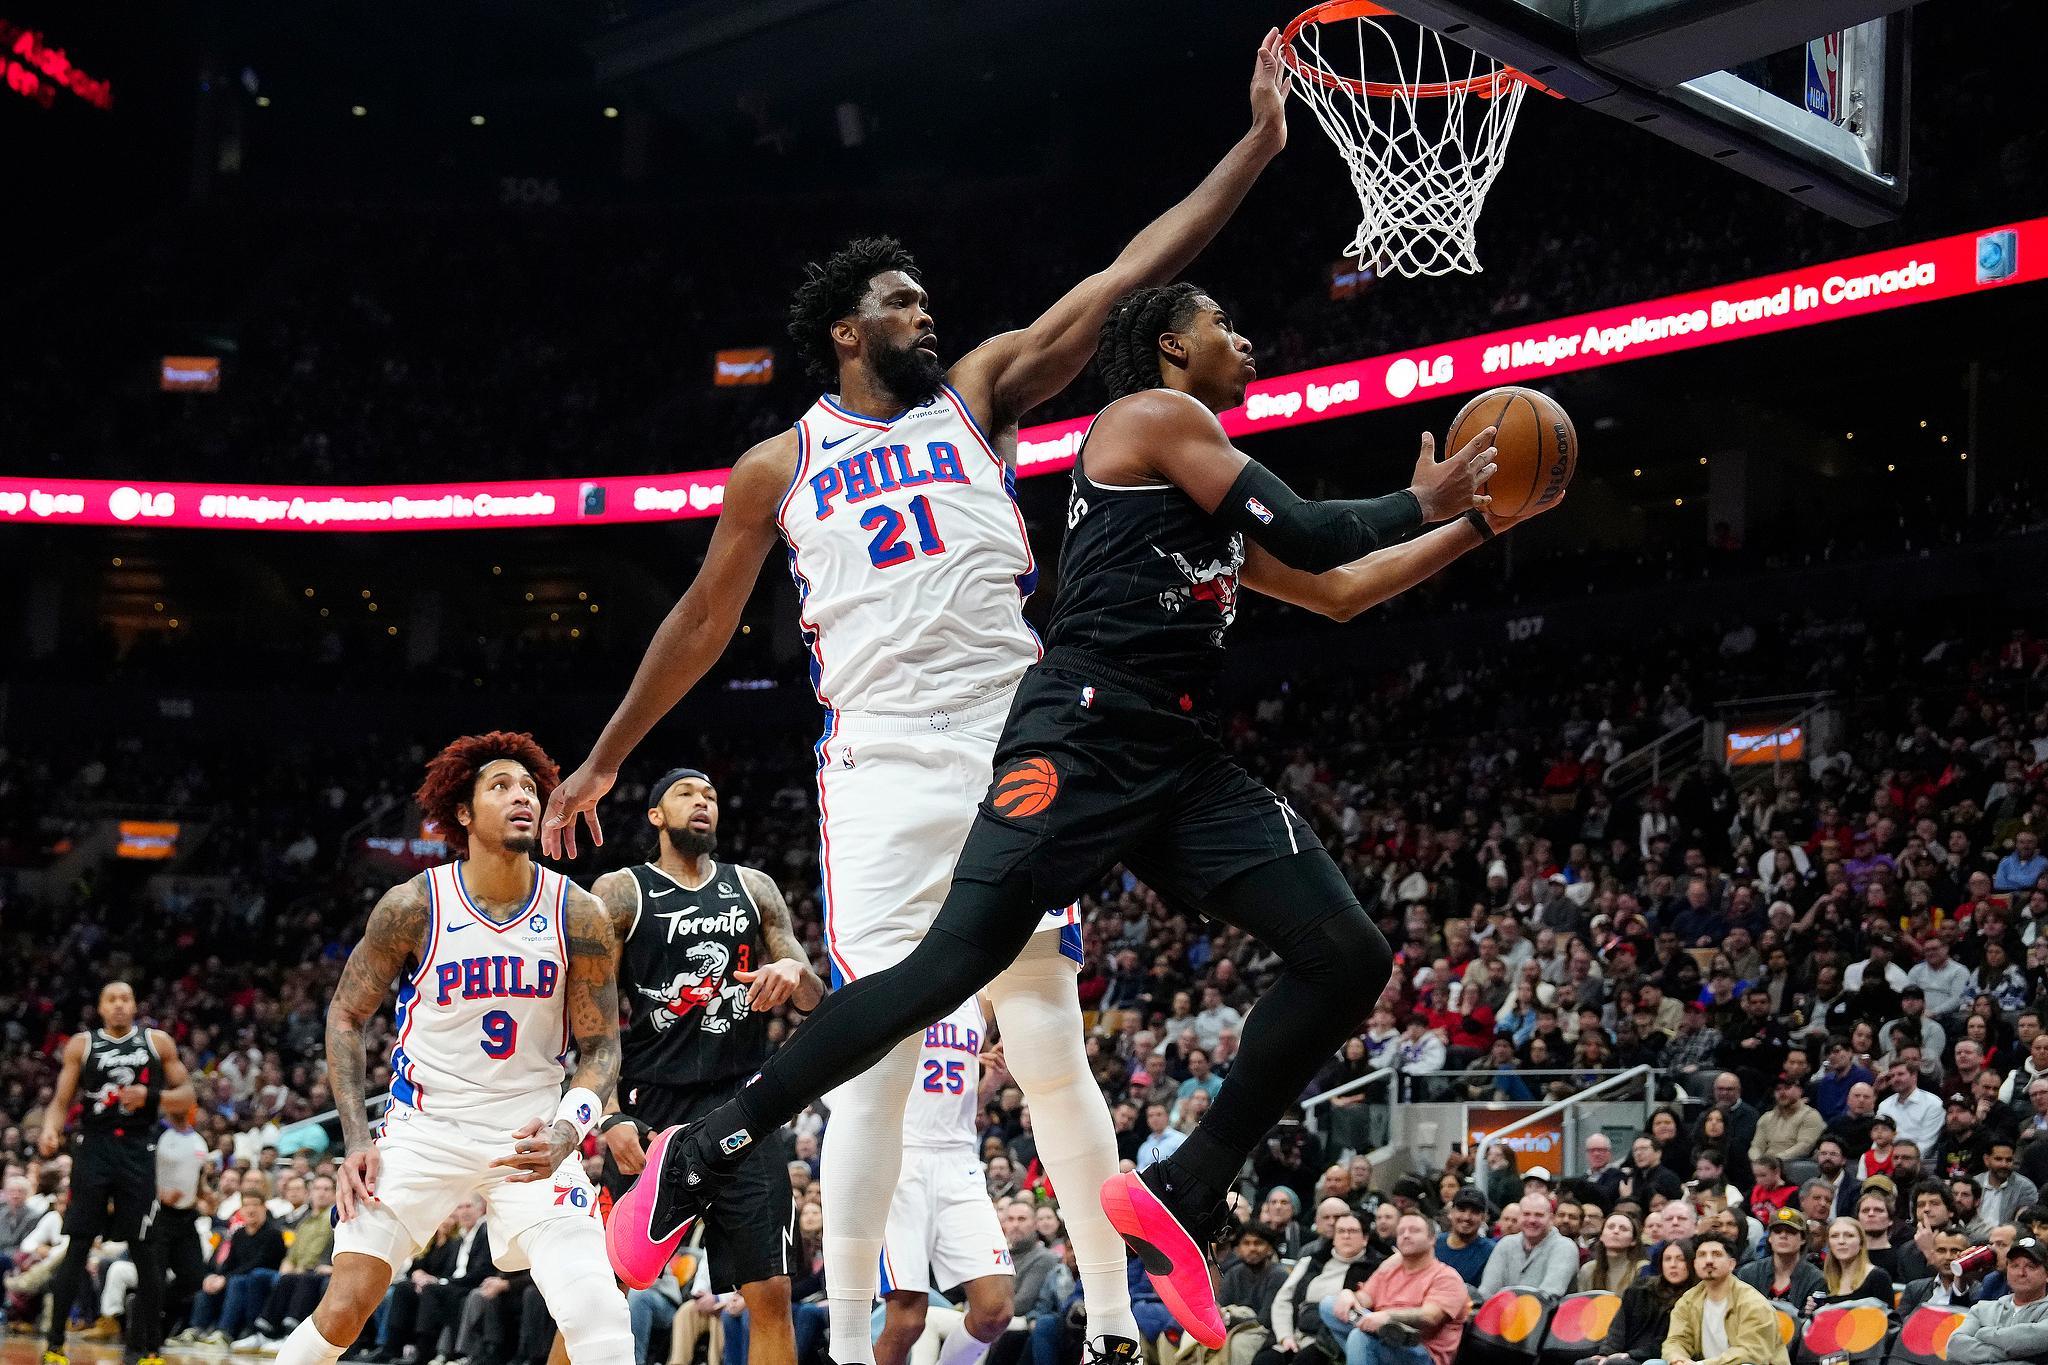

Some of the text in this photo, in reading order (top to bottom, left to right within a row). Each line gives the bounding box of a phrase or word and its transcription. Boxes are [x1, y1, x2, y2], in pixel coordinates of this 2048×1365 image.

[1809, 87, 1826, 112] NBA
[1418, 260, 1936, 387] LG #1 Major Appliance Brand in Canada
[908, 407, 950, 420] crypto.com
[1246, 392, 1302, 420] Shop
[1016, 432, 1073, 466] Brand
[1535, 422, 1568, 505] Wilson
[809, 441, 971, 521] PHILA
[140, 492, 175, 517] LG
[392, 496, 453, 519] Brand
[452, 495, 474, 517] in
[473, 491, 555, 517] Canada
[634, 486, 688, 513] Shop
[859, 494, 947, 570] 21
[1505, 616, 1545, 642] 107
[653, 904, 750, 945] Toronto
[737, 944, 751, 972] 3
[436, 955, 559, 1007] PHILA
[480, 1009, 519, 1061] 9
[924, 1022, 979, 1058] HILA
[923, 1059, 966, 1096] 25
[553, 1184, 588, 1208] 76
